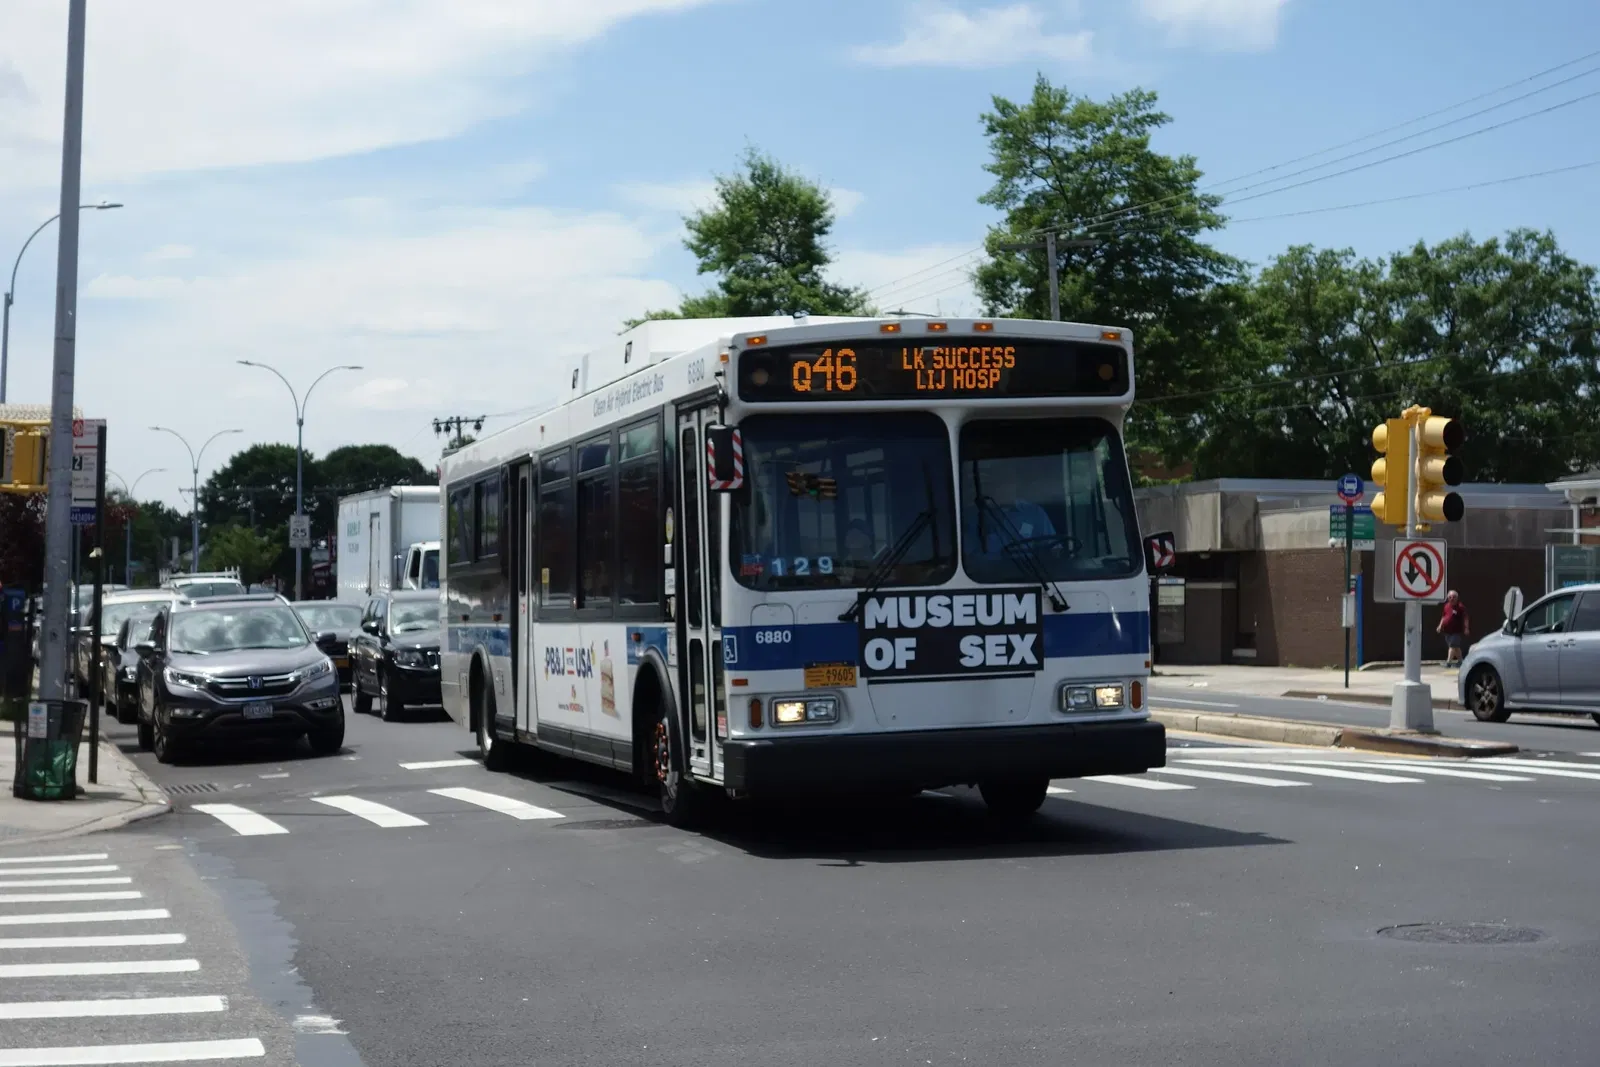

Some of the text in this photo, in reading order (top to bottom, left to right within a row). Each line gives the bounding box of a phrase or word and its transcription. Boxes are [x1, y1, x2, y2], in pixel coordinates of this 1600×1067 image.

[687, 358, 705, 385] 6880
[793, 348, 857, 391] Q46
[903, 346, 1016, 369] LK SUCCESS
[916, 368, 1001, 390] LIJ HOSP
[593, 398, 606, 417] Clean
[615, 384, 632, 413] Hybrid
[632, 376, 652, 402] Electric
[653, 373, 664, 394] Bus
[864, 593, 1037, 630] MUSEUM
[755, 630, 792, 644] 6880
[864, 633, 1039, 671] OF SEX
[545, 647, 593, 678] PB&J USA
